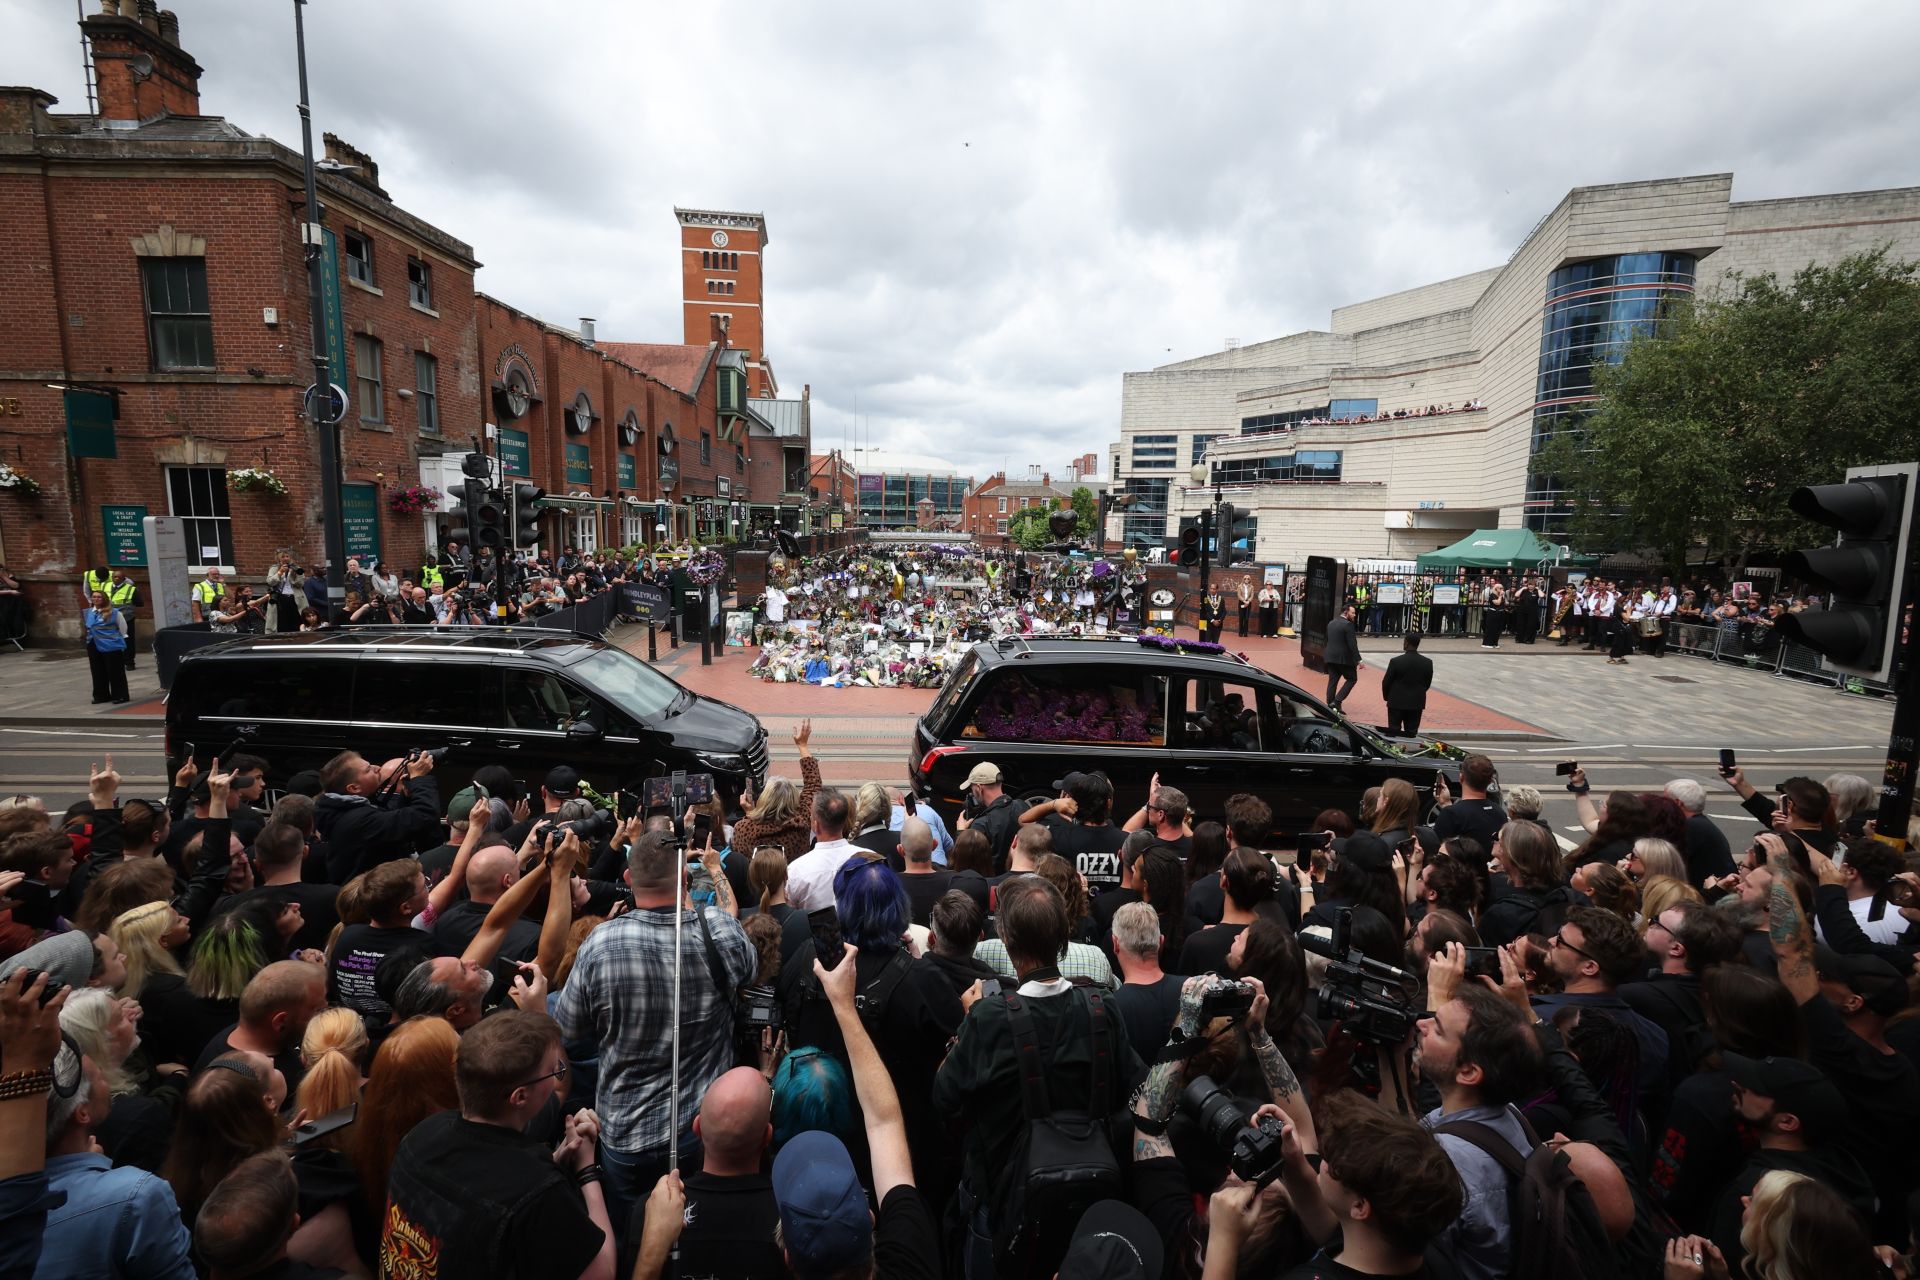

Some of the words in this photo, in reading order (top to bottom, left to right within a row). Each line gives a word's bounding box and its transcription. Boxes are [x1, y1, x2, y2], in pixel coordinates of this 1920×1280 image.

[322, 233, 339, 380] BRASSHOUS
[1419, 501, 1436, 510] BAY
[1438, 501, 1445, 510] C
[1076, 852, 1120, 875] OZZY
[348, 954, 371, 964] Saturday
[390, 1203, 431, 1254] Sabaton
